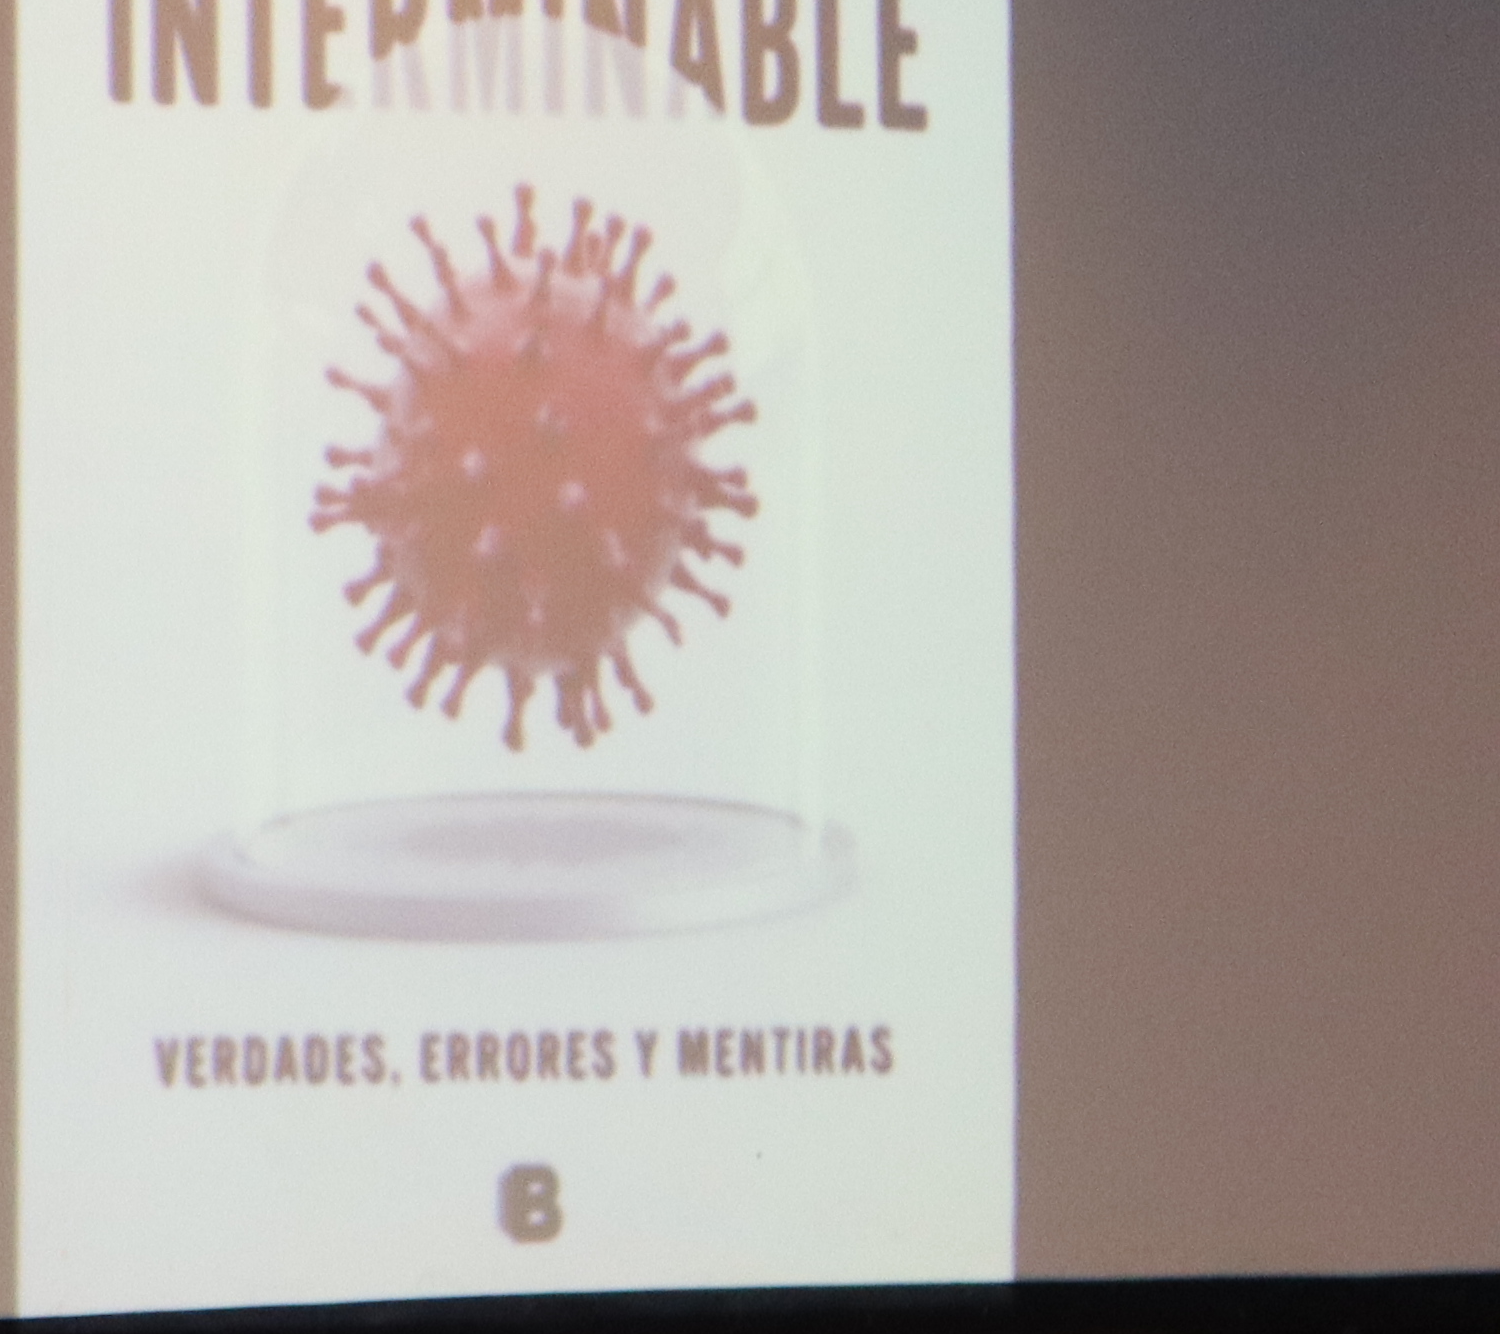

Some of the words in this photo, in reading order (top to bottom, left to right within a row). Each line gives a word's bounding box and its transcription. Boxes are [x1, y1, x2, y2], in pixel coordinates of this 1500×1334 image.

[153, 1032, 402, 1090] VERDADES,
[418, 1028, 617, 1084] ERRORES
[633, 1029, 659, 1079] Y
[675, 1024, 895, 1079] MENTIRAS
